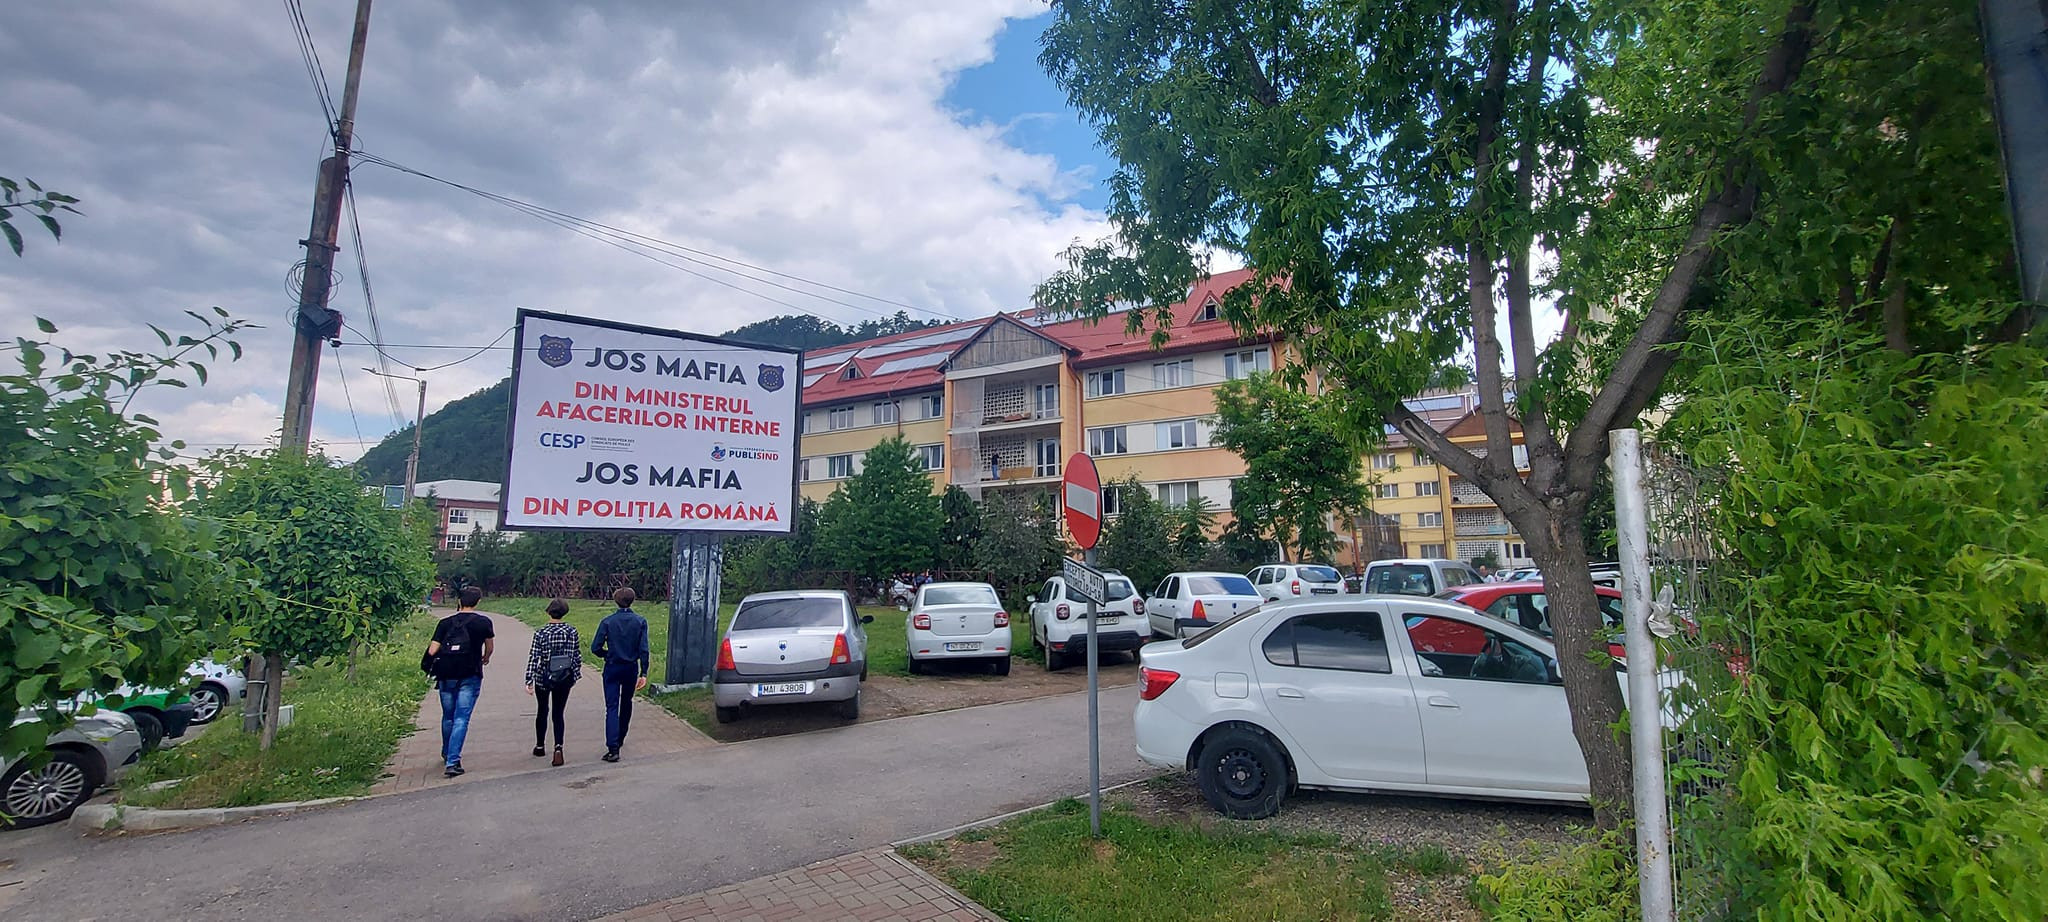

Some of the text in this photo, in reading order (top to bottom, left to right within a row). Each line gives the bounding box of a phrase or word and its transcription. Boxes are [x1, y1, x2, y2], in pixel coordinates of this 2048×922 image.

[585, 347, 647, 373] JOS
[656, 354, 747, 386] MAFIA
[575, 381, 754, 415] DIN MINISTERUL
[536, 400, 781, 437] AFACERILOR INTERNE
[539, 432, 586, 449] CESP
[729, 450, 779, 461] PUBLISIND
[576, 461, 742, 490] JOS MAFIA
[523, 497, 779, 523] DIN POLIȚIA ROMÂNĂ
[1089, 573, 1103, 590] AUTO
